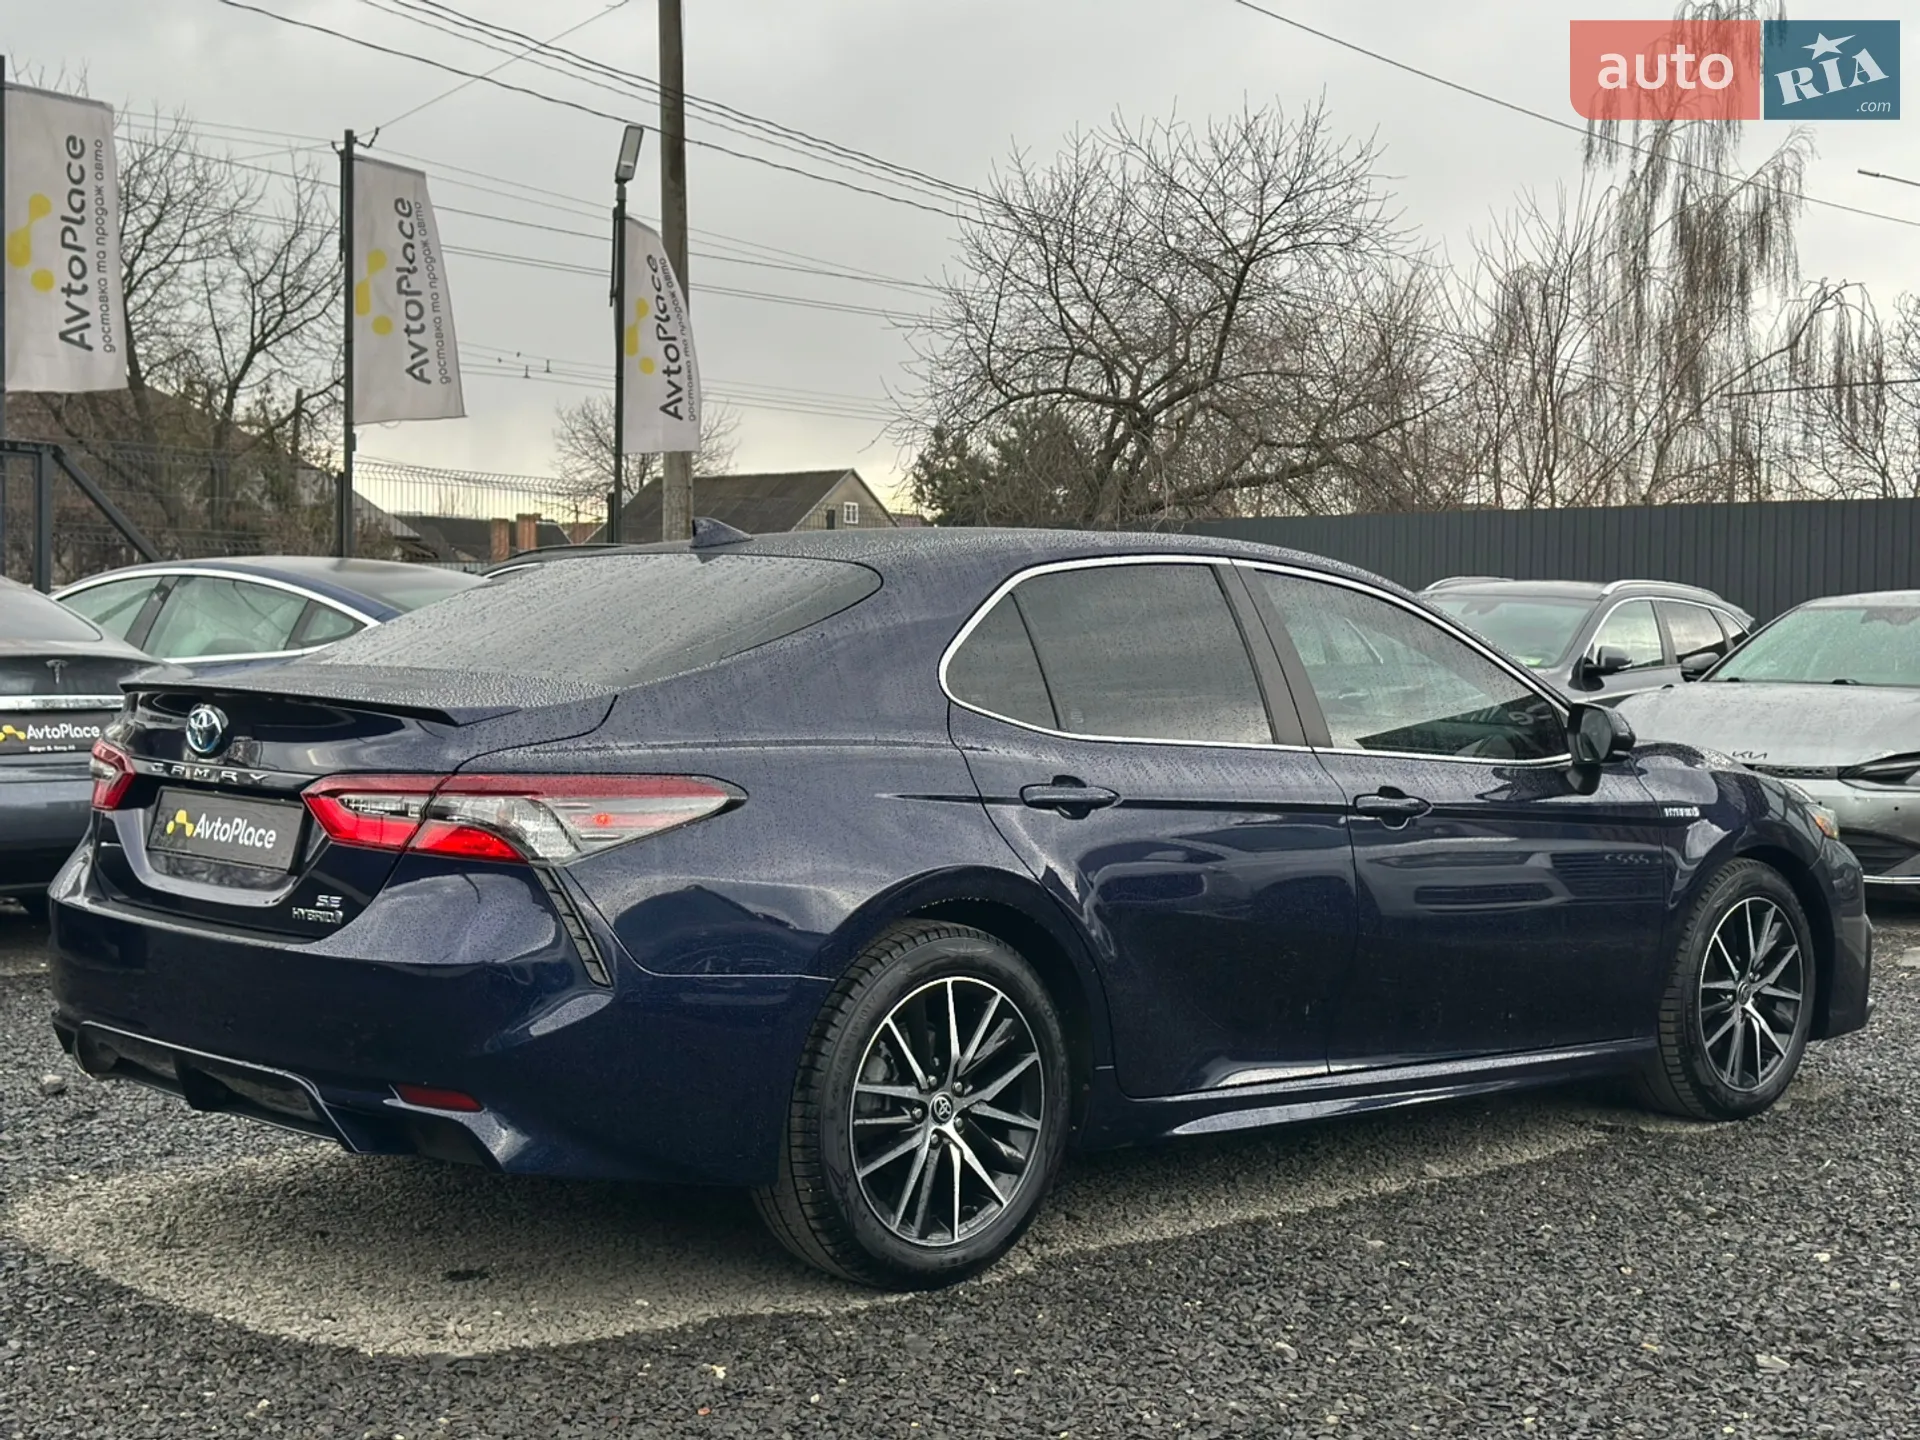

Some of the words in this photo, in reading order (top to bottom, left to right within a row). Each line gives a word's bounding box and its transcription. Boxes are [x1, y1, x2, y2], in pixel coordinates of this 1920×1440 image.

[93, 139, 104, 181] авто
[94, 184, 108, 247] продаж
[414, 201, 428, 237] авто
[58, 134, 94, 352] AvtoPlace
[97, 249, 109, 275] та
[422, 240, 439, 289] продаж
[659, 257, 675, 290] авто
[394, 197, 432, 385] AvtoPlace
[429, 292, 441, 313] та
[99, 278, 116, 354] доставка
[433, 316, 452, 385] доставка
[646, 254, 684, 421] AvtoPlace
[684, 361, 697, 422] доставка
[26, 723, 100, 740] AvtoPlace
[150, 762, 269, 783] CAMRY
[192, 812, 277, 849] AvtoPlace
[315, 894, 343, 908] SE
